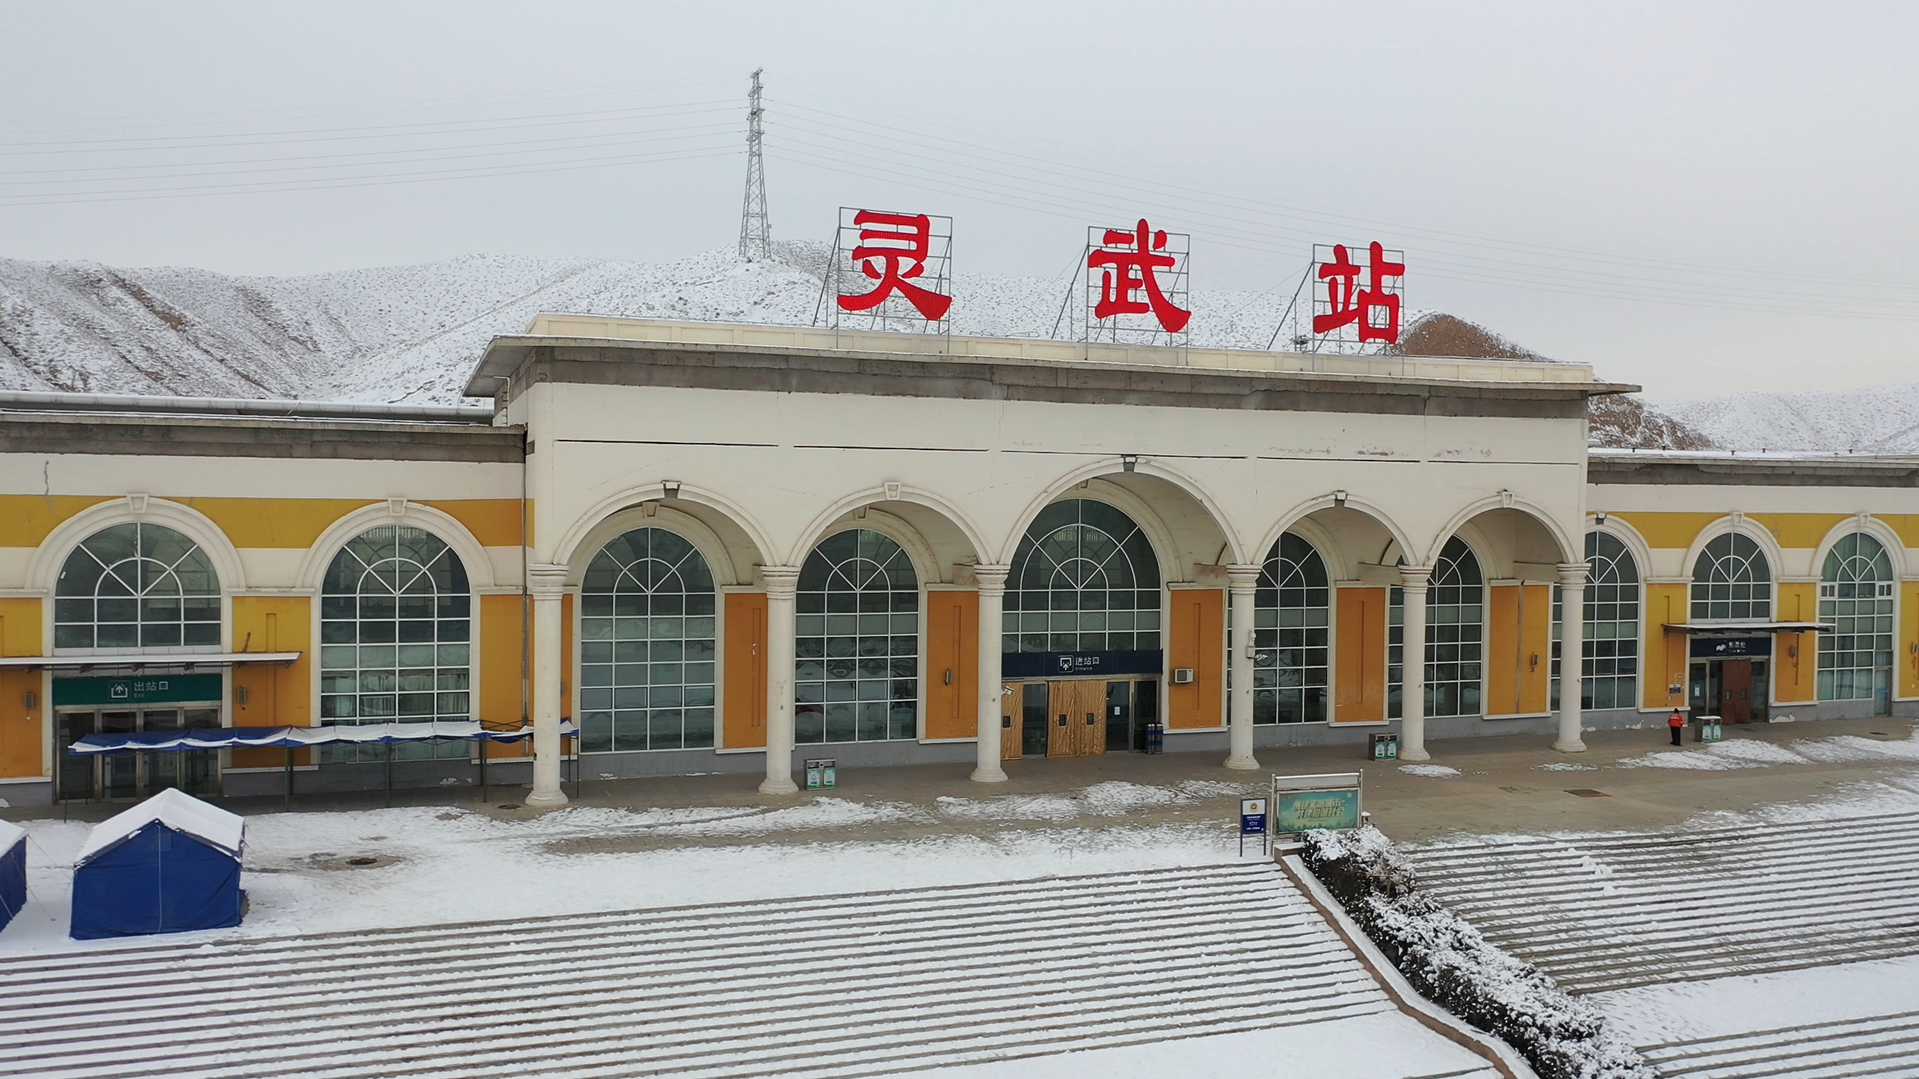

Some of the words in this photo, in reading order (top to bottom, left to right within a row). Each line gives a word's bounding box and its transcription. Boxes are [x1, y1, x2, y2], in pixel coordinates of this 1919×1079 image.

[836, 210, 1405, 344] 灵武站
[1075, 656, 1100, 666] 进站口
[133, 681, 169, 692] 出站口
